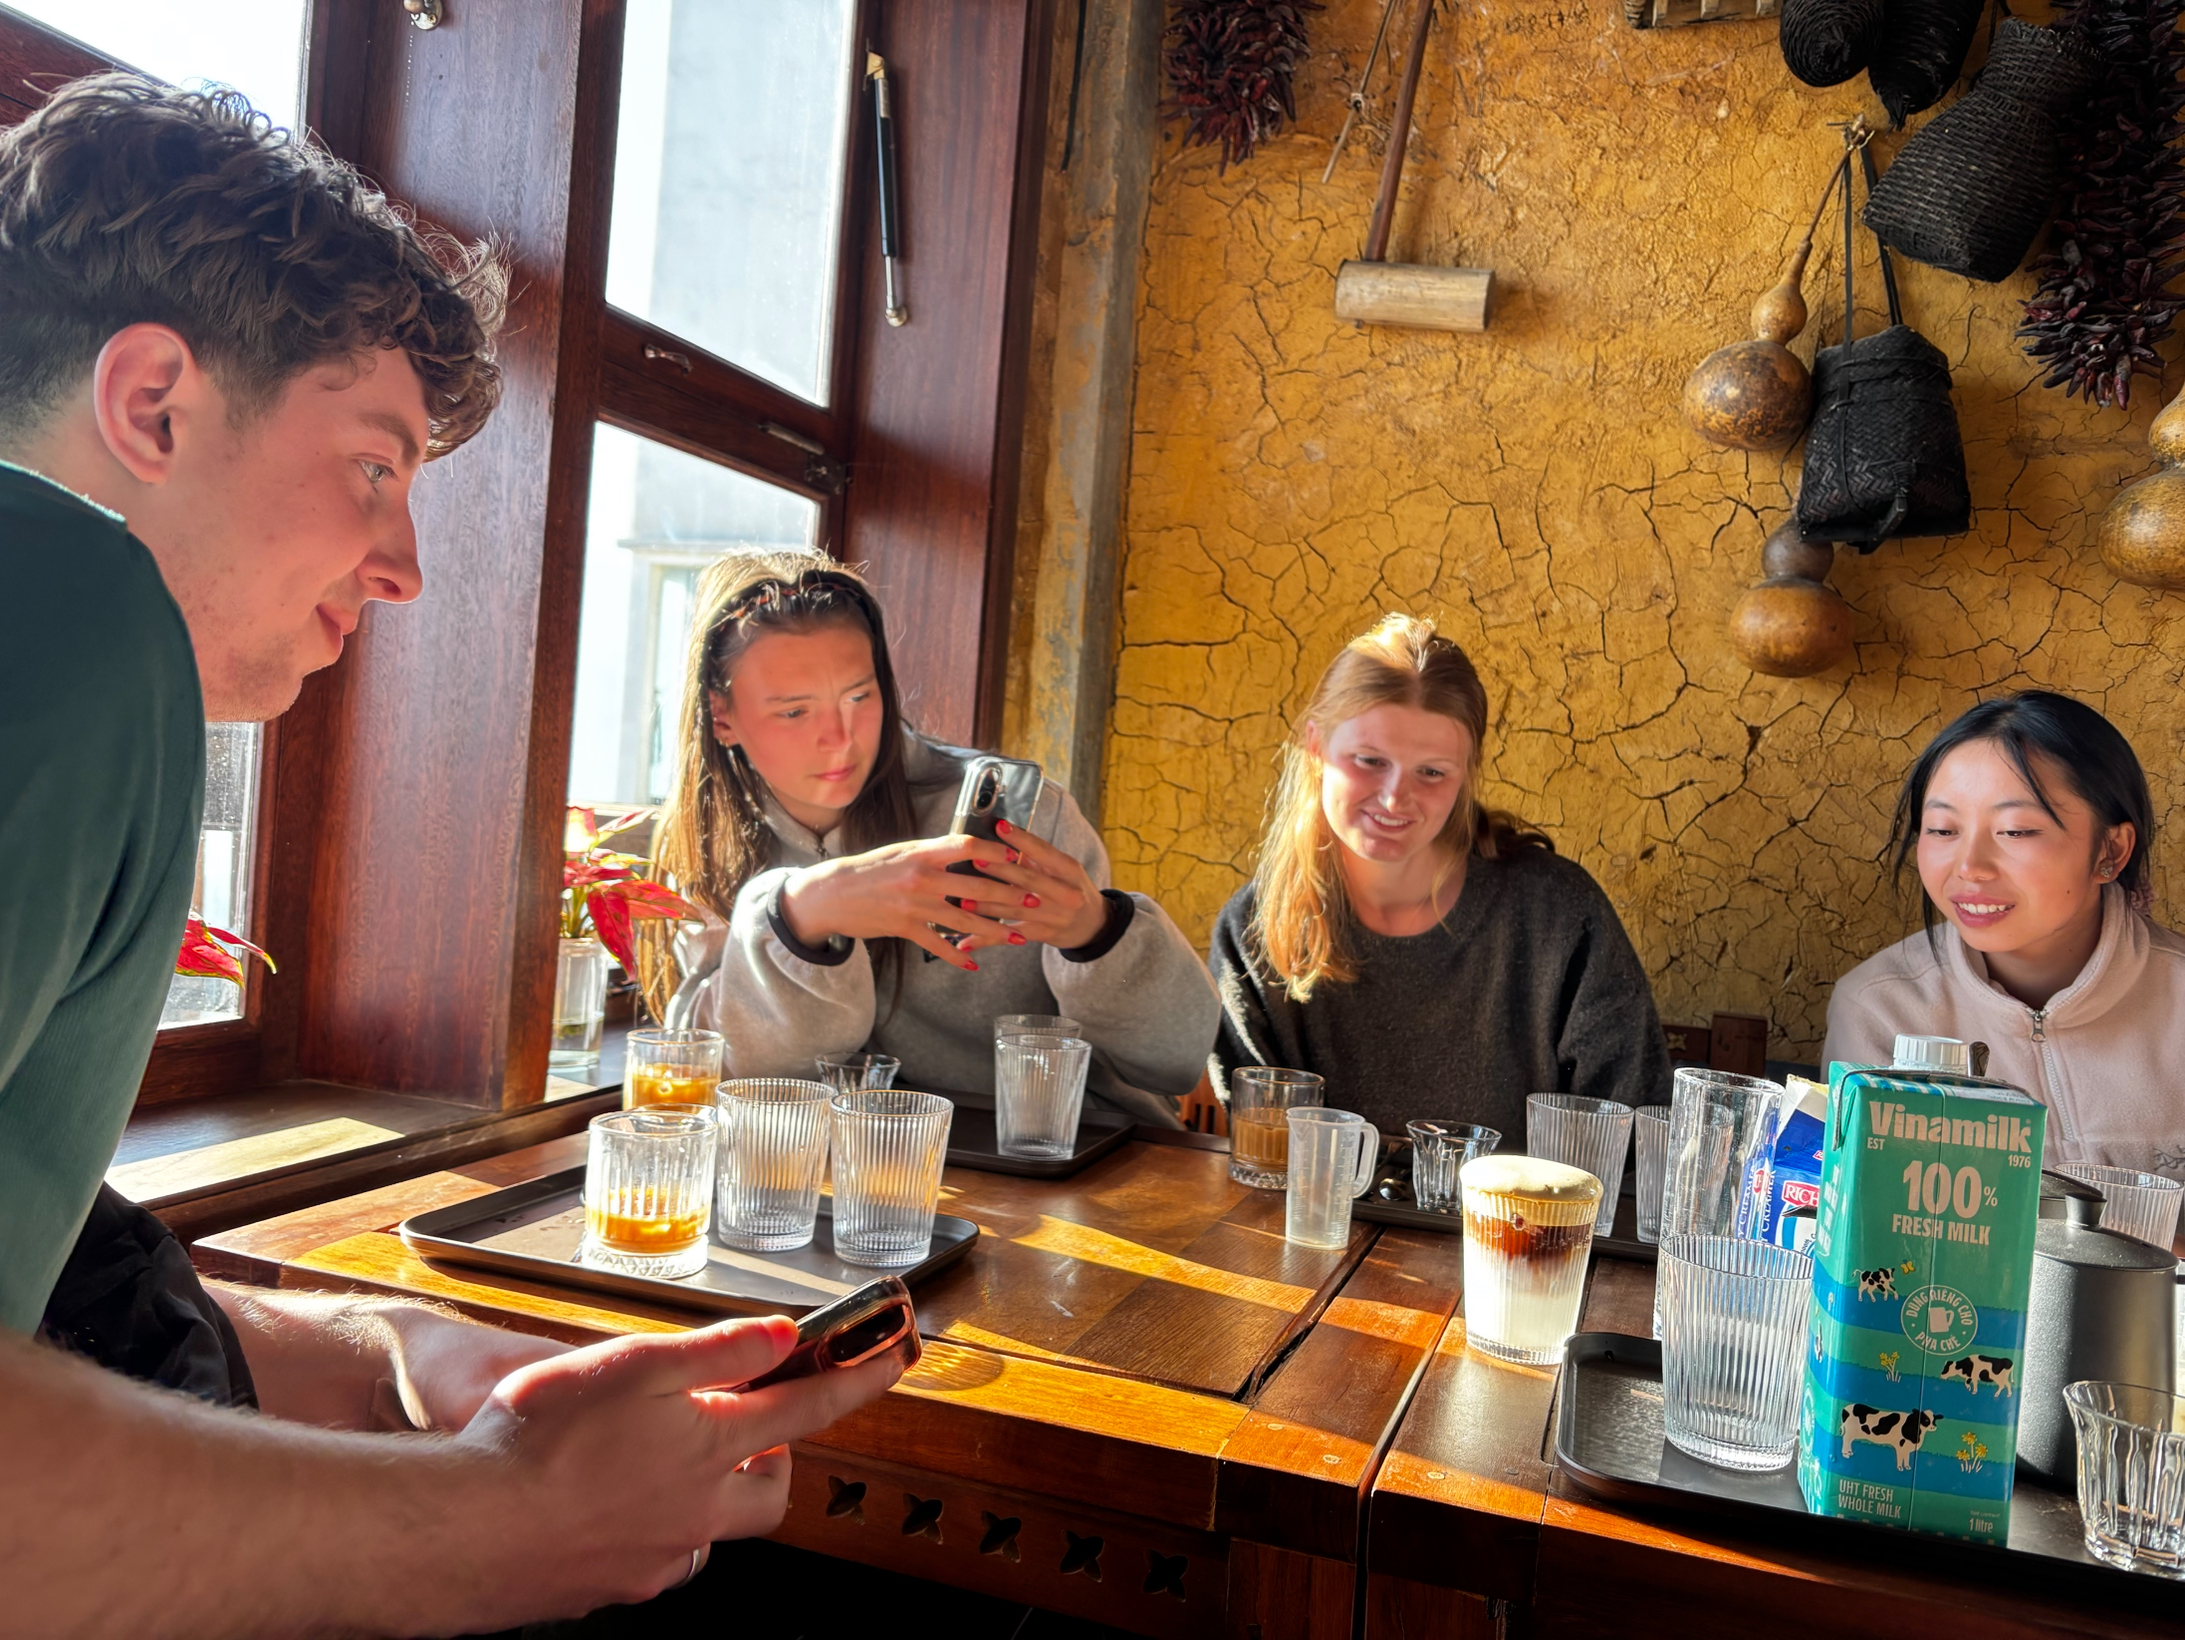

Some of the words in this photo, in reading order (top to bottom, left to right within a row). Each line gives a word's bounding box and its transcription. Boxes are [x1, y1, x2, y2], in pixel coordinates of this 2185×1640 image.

[1869, 1101, 2031, 1153] Vinamilk
[1867, 1137, 1885, 1150] EST
[2008, 1154, 2031, 1168] 1976
[1903, 1160, 1998, 1218] 100%
[1892, 1213, 1943, 1239] FRESH
[1947, 1223, 1991, 1246] MILK
[1957, 1305, 1974, 1326] CHO
[1839, 1479, 1860, 1497] UHT
[1862, 1483, 1894, 1502] FRESH
[1838, 1495, 1874, 1514] WHOLE
[1876, 1501, 1902, 1519] MILK
[1969, 1517, 1974, 1531] 1
[1975, 1518, 1993, 1533] litre
